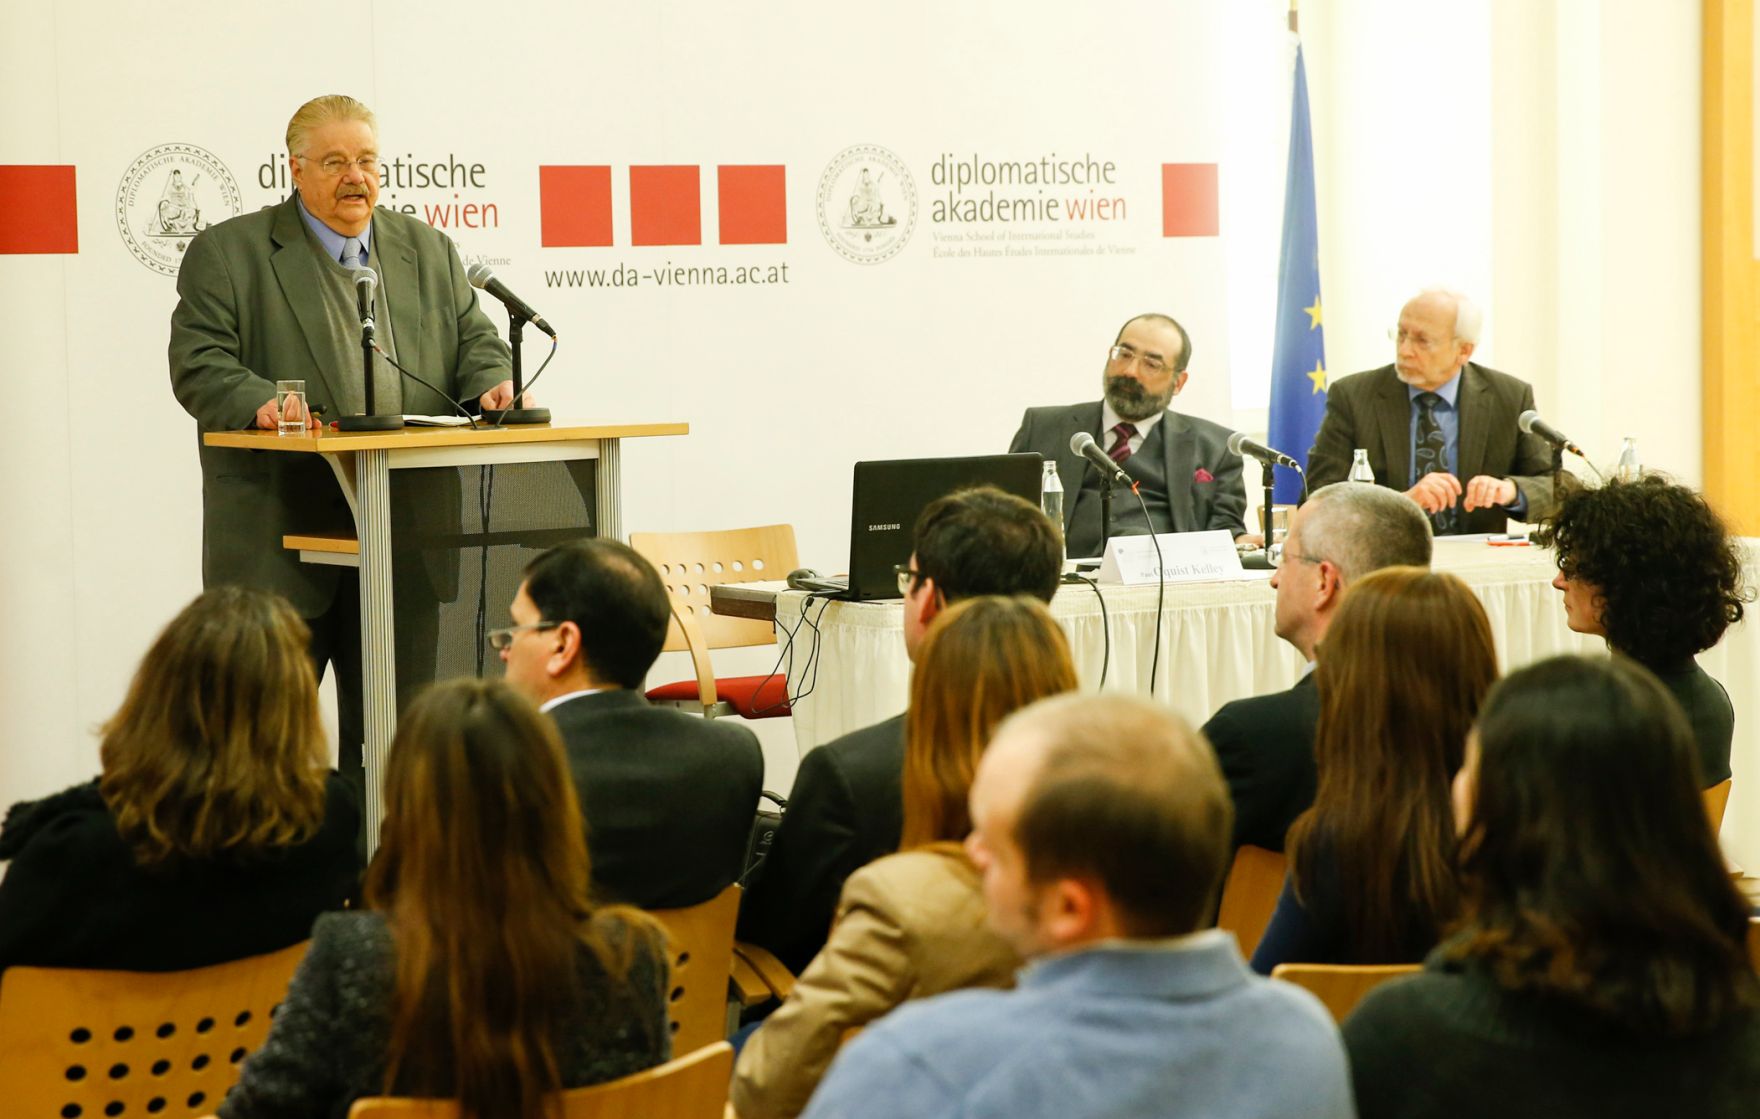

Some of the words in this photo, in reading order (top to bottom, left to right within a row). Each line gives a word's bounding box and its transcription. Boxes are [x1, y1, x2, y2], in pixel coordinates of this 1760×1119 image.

[127, 156, 175, 208] DIPLOMATISCHE
[180, 155, 219, 181] AKADEMIE
[258, 153, 486, 197] diatische
[931, 152, 1117, 194] diplomatische
[424, 193, 499, 229] wien
[931, 189, 1060, 223] akademie
[1065, 188, 1127, 221] wien
[932, 231, 963, 243] Vienna
[966, 231, 995, 242] School
[996, 231, 1007, 241] of
[1008, 229, 1063, 241] International
[1065, 229, 1096, 240] Studies
[462, 255, 474, 266] de
[476, 254, 512, 266] Vienne
[957, 247, 971, 258] des
[974, 247, 1002, 258] Hautes
[1034, 244, 1095, 257] Internationales
[1096, 244, 1106, 256] de
[1107, 243, 1137, 256] Vienne
[544, 260, 790, 288] www.da-vienna.ac.at
[868, 523, 900, 532] SAMSUNG
[1191, 563, 1225, 576] Kelley
